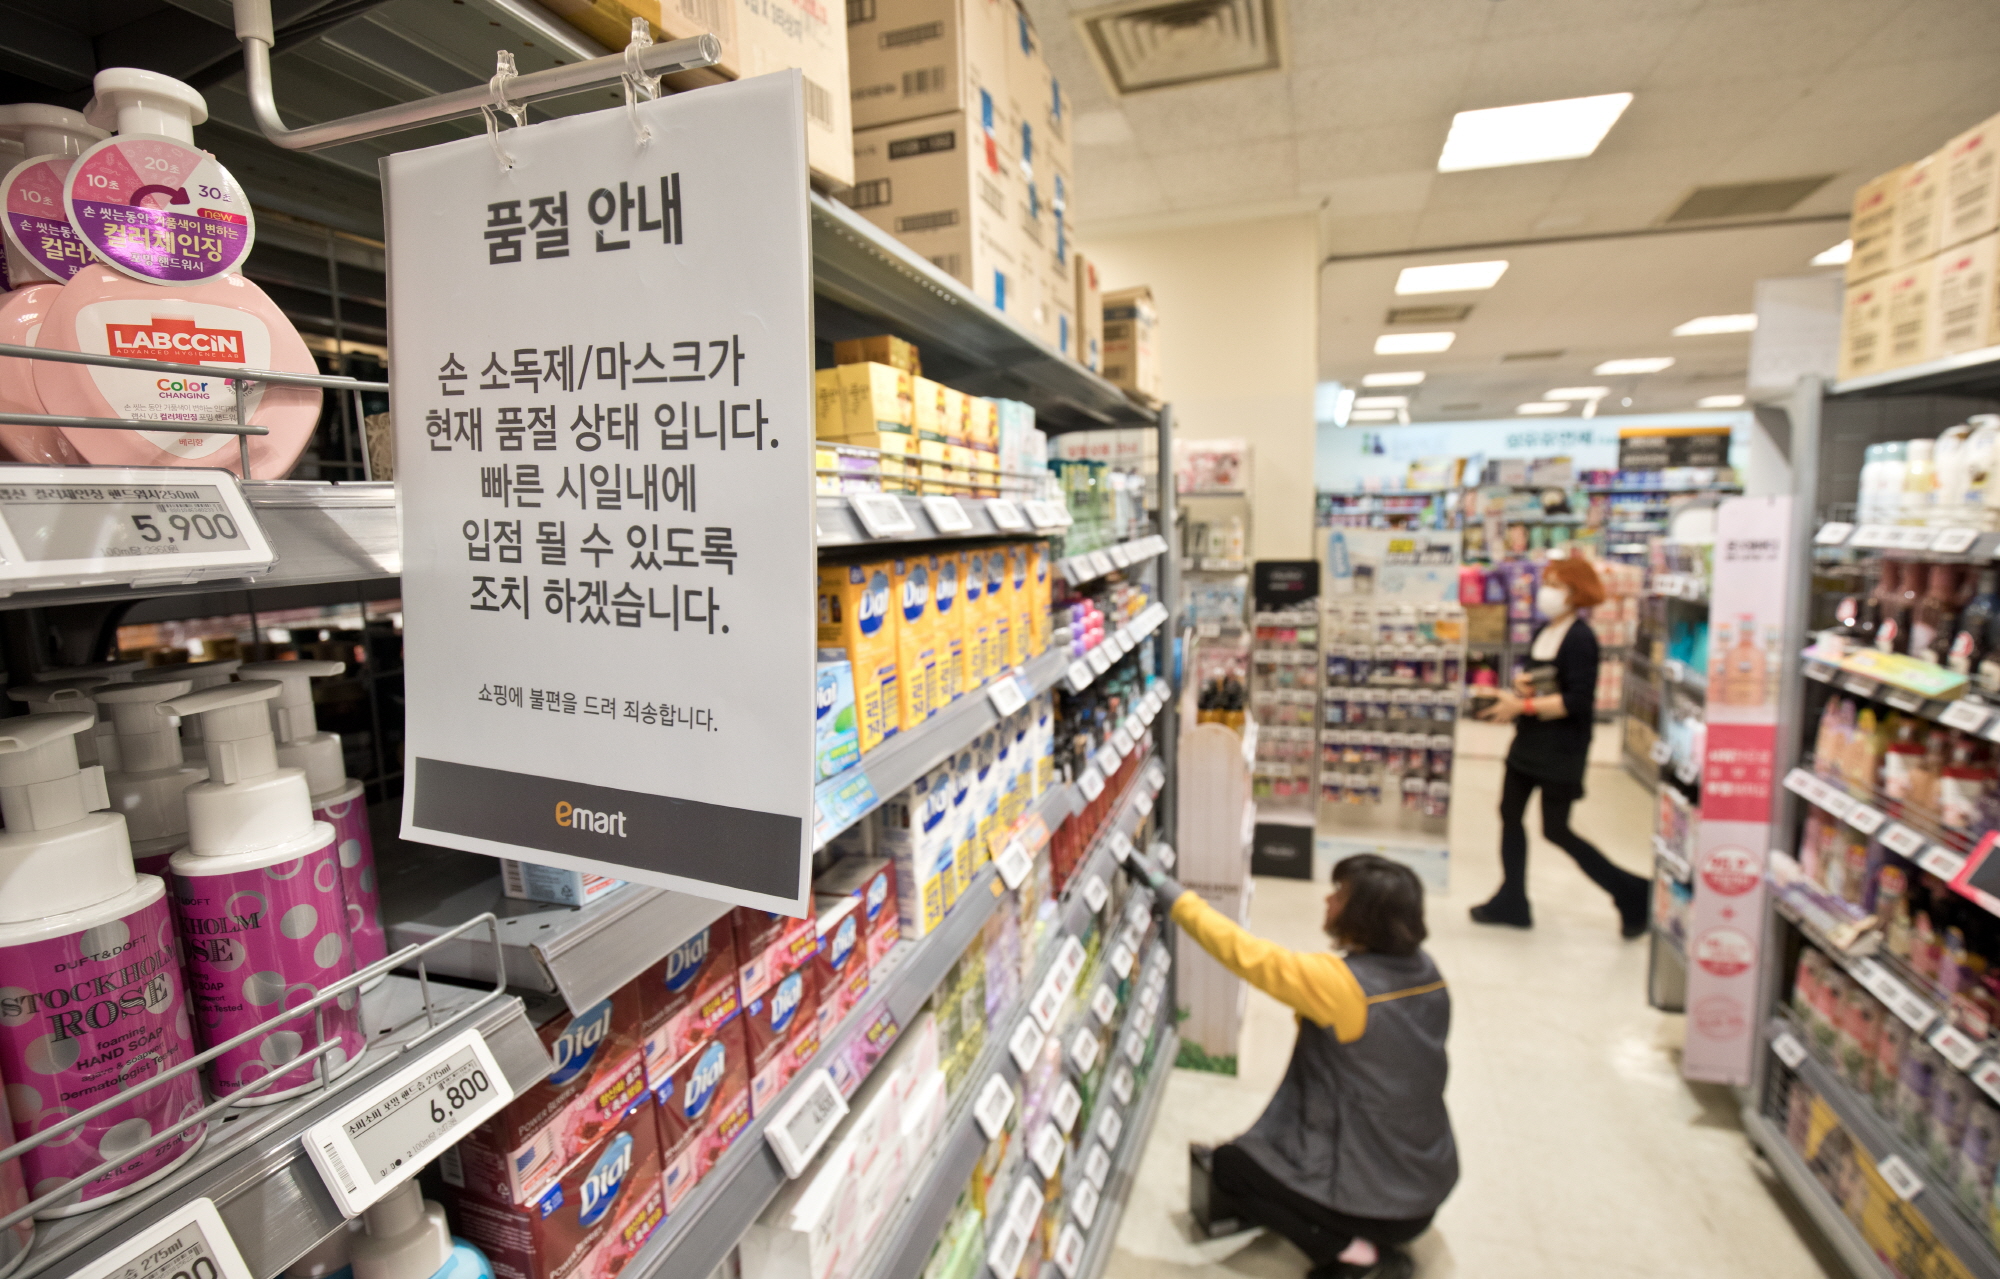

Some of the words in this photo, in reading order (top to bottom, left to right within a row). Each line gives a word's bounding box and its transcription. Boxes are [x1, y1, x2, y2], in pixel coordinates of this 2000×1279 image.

[86, 174, 120, 190] 10초
[144, 157, 180, 175] 20초
[20, 189, 54, 207] 10초
[198, 185, 232, 203] 30초
[20, 220, 33, 232] 손
[83, 205, 97, 218] 손
[100, 207, 149, 225] 씻는동안
[205, 223, 239, 240] 변하는
[204, 209, 232, 222] new
[484, 191, 570, 265] 품절
[588, 172, 684, 253] 안내
[104, 223, 223, 262] 컬러체인징
[131, 252, 154, 266] 포밍
[158, 255, 204, 273] 핸드워시
[174, 350, 217, 358] HYGIENE
[437, 352, 469, 397] 손
[479, 334, 746, 395] 소독제/마스크가
[156, 378, 209, 393] Color
[159, 392, 211, 400] CHANGING
[148, 403, 163, 411] 동안
[159, 413, 198, 422] 컬러체인징
[199, 413, 214, 421] 포밍
[178, 438, 204, 447] 베리향
[425, 406, 483, 452] 현재
[495, 405, 558, 452] 품절
[570, 402, 640, 453] 상태
[654, 399, 780, 452] 입니다.
[480, 463, 545, 508] 빠른
[556, 462, 697, 513] 시일내에
[131, 513, 239, 544] 5,900
[462, 518, 523, 564] 입점
[535, 520, 567, 567] 될
[580, 522, 614, 568] 수
[627, 523, 738, 576] 있도록
[470, 574, 530, 619] 조치
[543, 577, 731, 636] 하겠습니다.
[477, 682, 523, 709] 쇼핑에
[528, 687, 578, 715] 불편을
[583, 695, 617, 720] 드려
[623, 700, 719, 732] 죄송합니다.
[816, 682, 838, 710] ial
[555, 800, 627, 838] emart
[55, 935, 148, 973] DUFT&DOFT
[667, 930, 710, 988] Dial
[0, 943, 178, 1018] STOCKHOLM
[46, 973, 169, 1044] ROSE
[213, 1003, 243, 1013] Tested
[771, 982, 803, 1029] Dial
[76, 1047, 125, 1071] HAND
[128, 1027, 164, 1052] SOAP
[96, 1025, 147, 1051] foaming
[551, 1003, 612, 1074] Dial
[81, 1067, 114, 1083] agave
[116, 1062, 124, 1070] &
[126, 1041, 165, 1067] soapwort
[684, 1050, 726, 1108] Dial
[60, 1061, 151, 1102] Dermatologist
[218, 1079, 232, 1088] 275
[430, 1069, 489, 1124] 6,800
[348, 1108, 382, 1137] 소피소피
[425, 1063, 452, 1085] 275ml
[127, 1160, 144, 1171] oz.
[154, 1142, 172, 1157] 275
[579, 1141, 634, 1219] Dial
[541, 1200, 553, 1217] 3
[141, 1237, 185, 1272] 275ml
